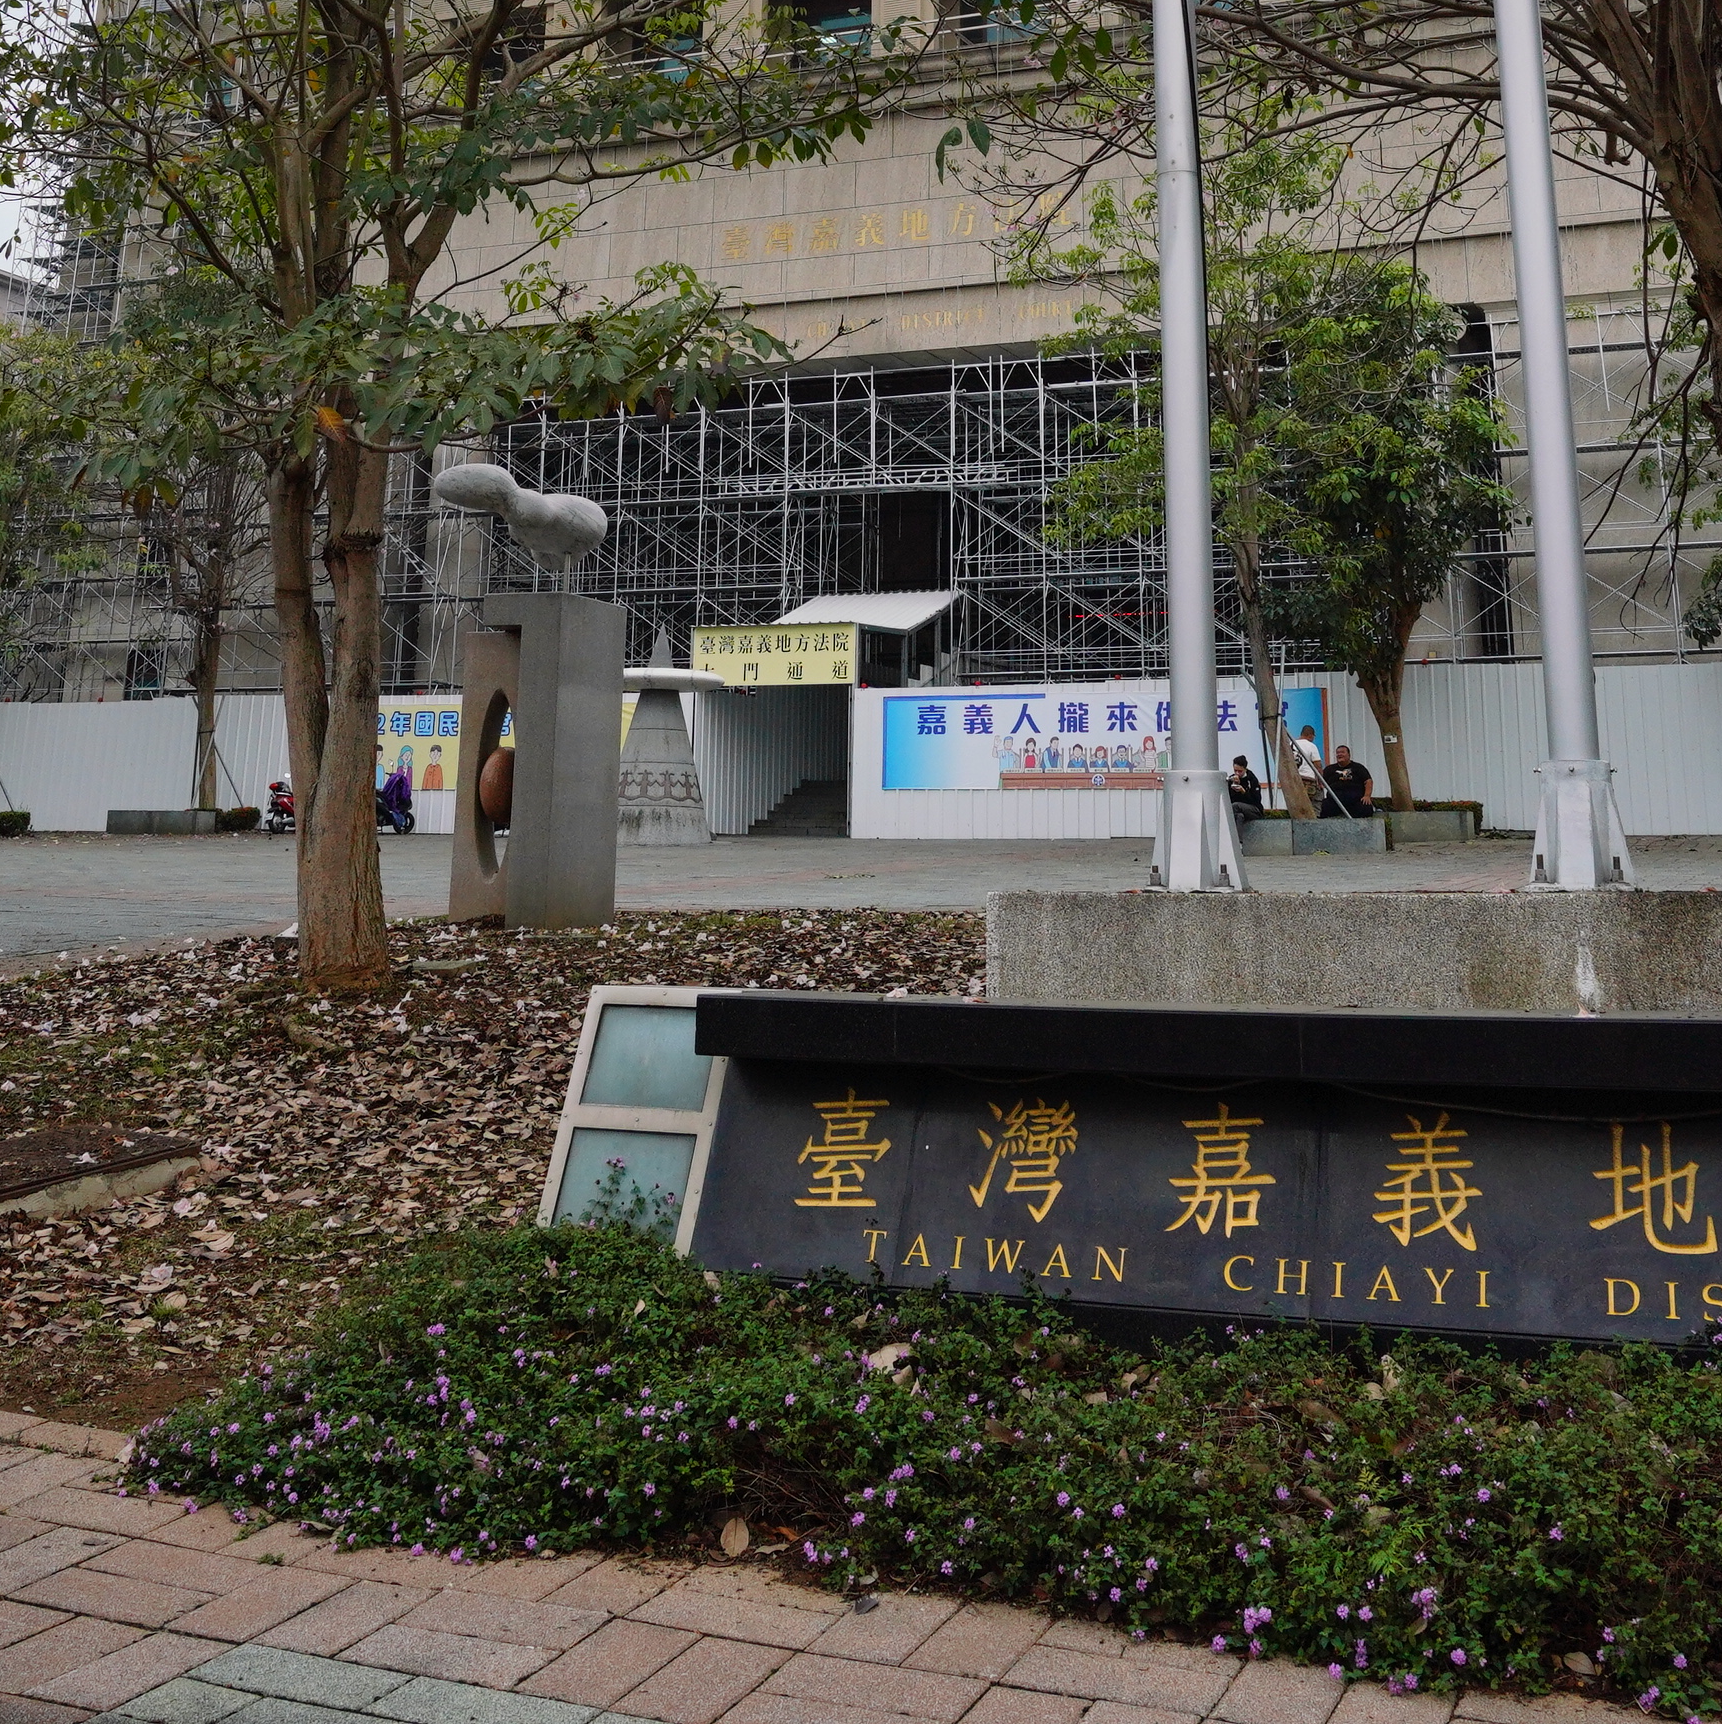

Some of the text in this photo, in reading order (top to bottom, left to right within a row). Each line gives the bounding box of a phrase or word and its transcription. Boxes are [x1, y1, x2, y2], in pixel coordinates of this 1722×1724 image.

[700, 632, 849, 655] 臺灣嘉義地方法院
[918, 702, 1289, 736] 嘉義人攏來法
[863, 1229, 1129, 1283] TAIWAN
[1223, 1256, 1491, 1308] CHIAYI
